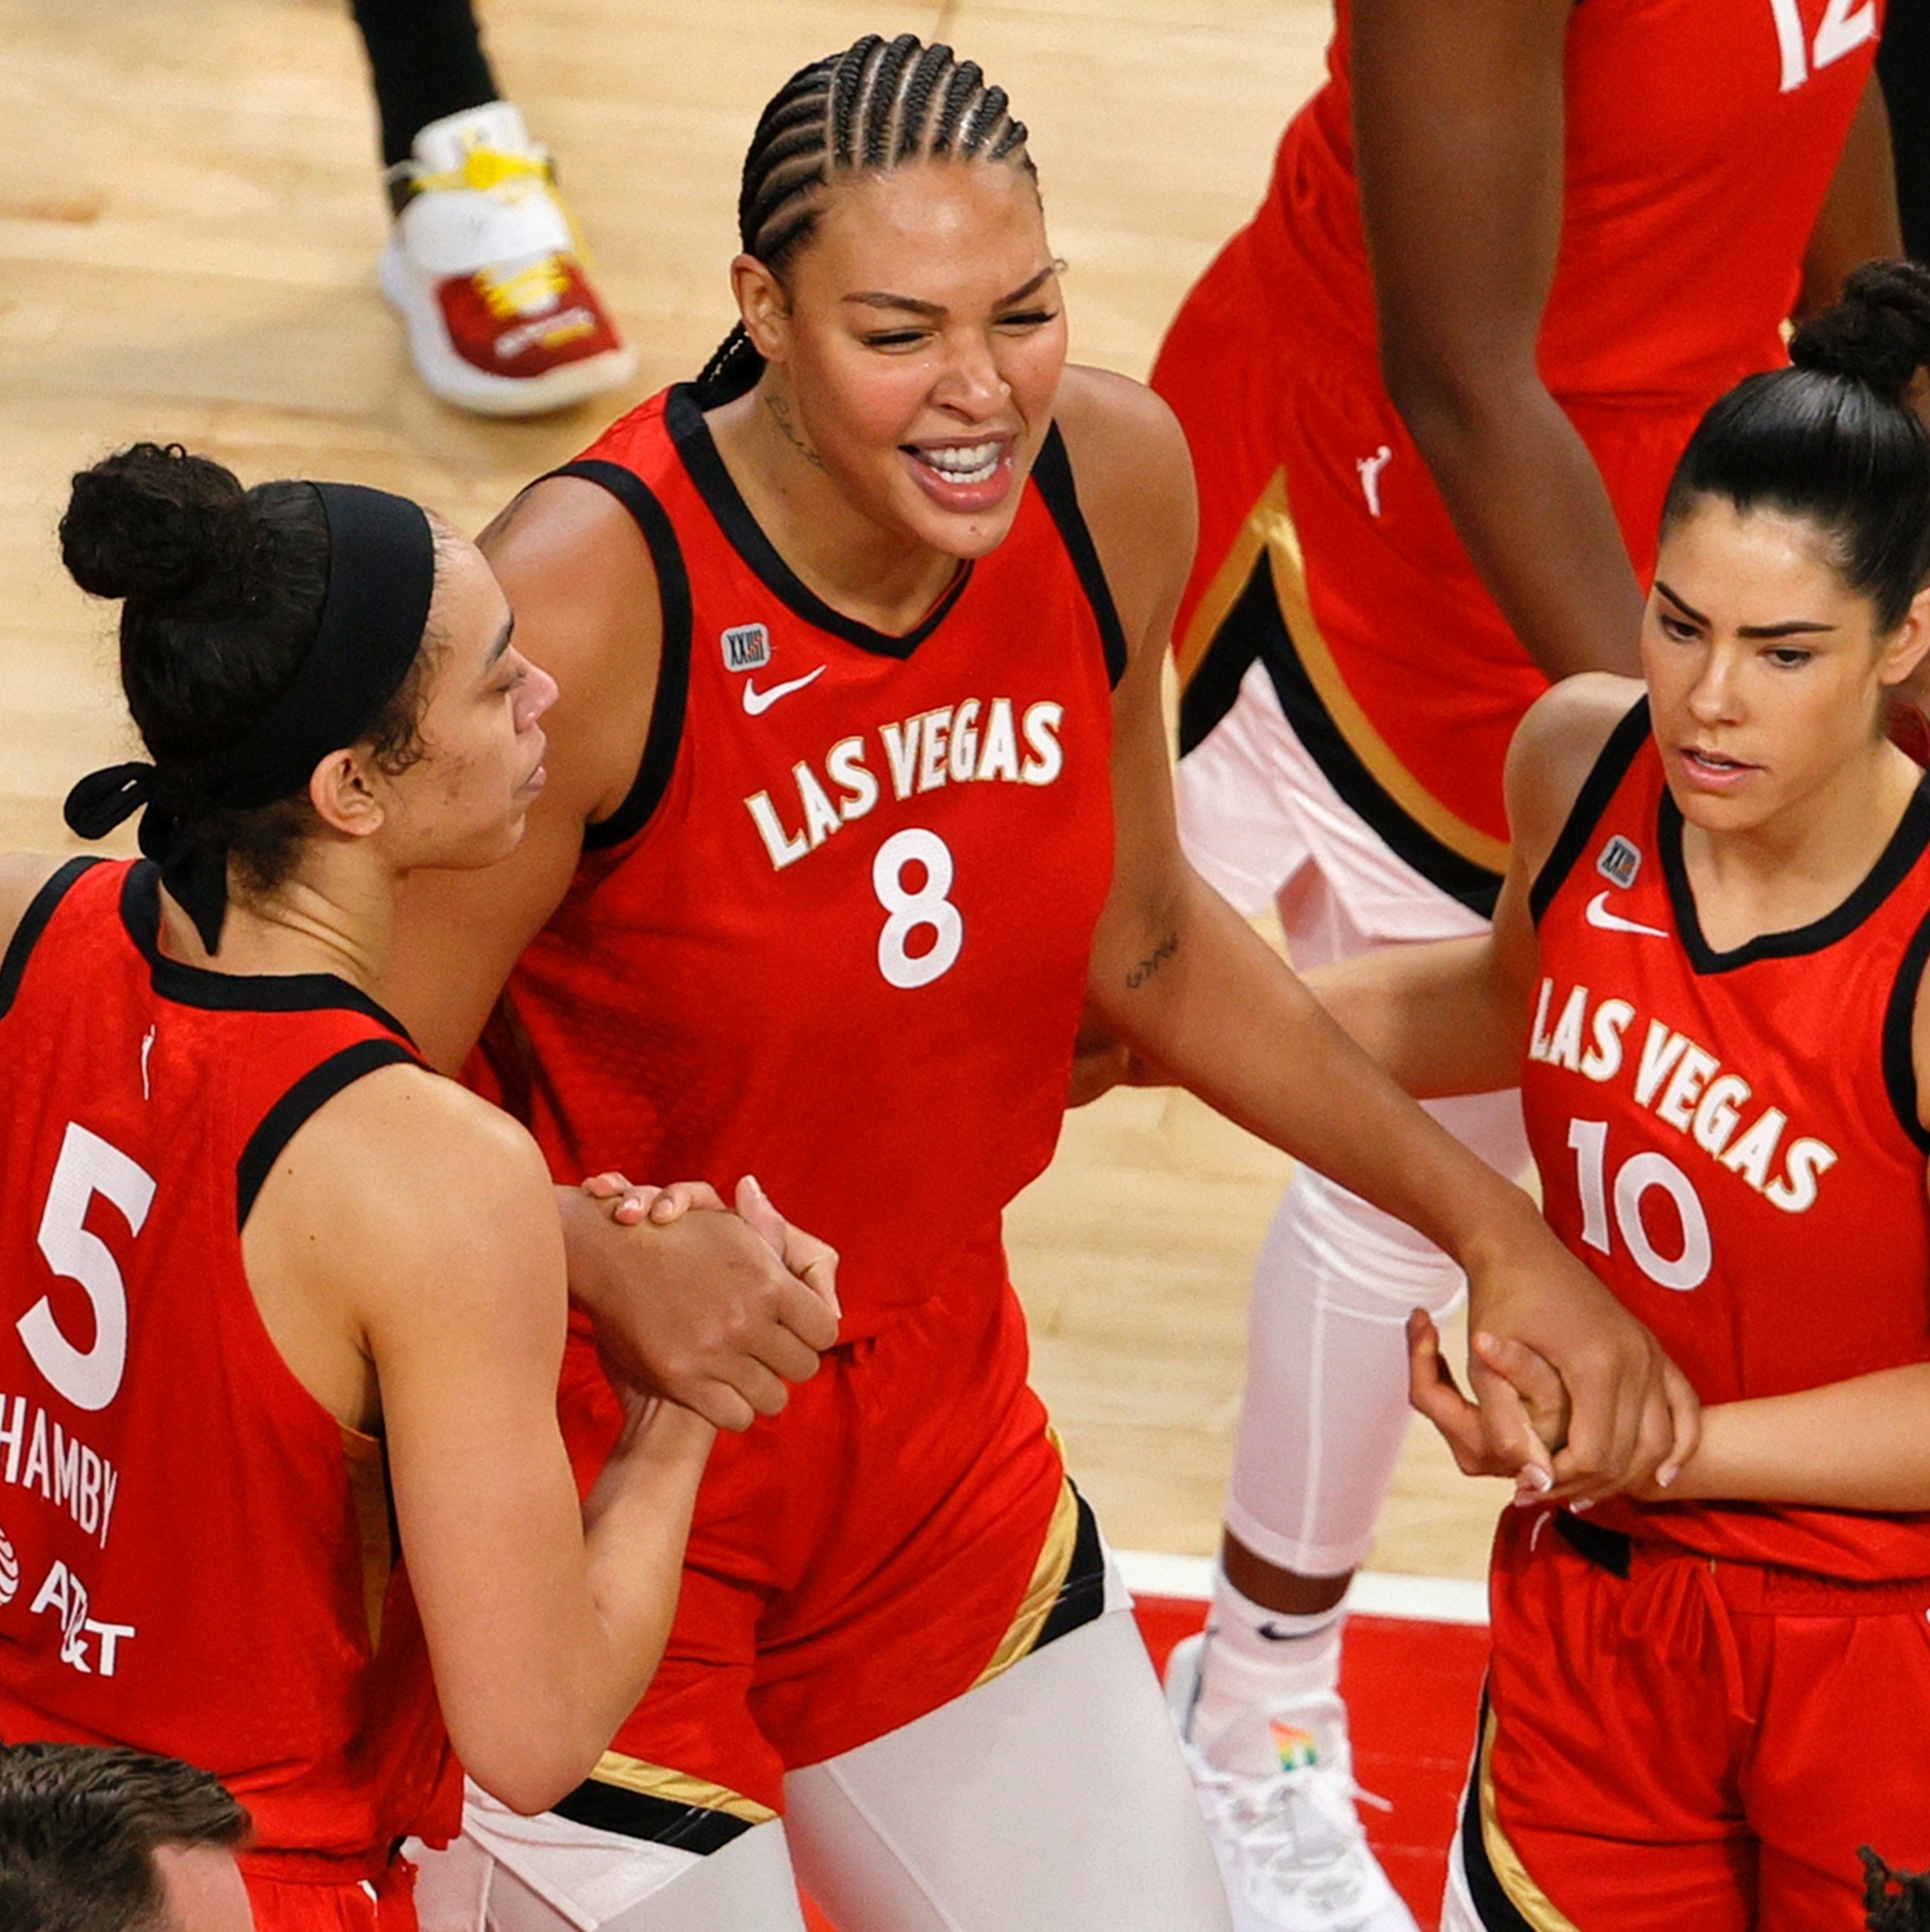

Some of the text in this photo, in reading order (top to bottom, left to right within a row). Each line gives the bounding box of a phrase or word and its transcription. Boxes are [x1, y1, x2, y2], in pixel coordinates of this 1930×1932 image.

[743, 698, 1064, 871] LAS VEGAS
[872, 828, 964, 989] 8
[1528, 977, 1838, 1212] LAS VEGAS
[15, 1120, 158, 1411] 5
[1567, 1117, 1712, 1290] 10
[0, 1393, 118, 1549] HAMBY
